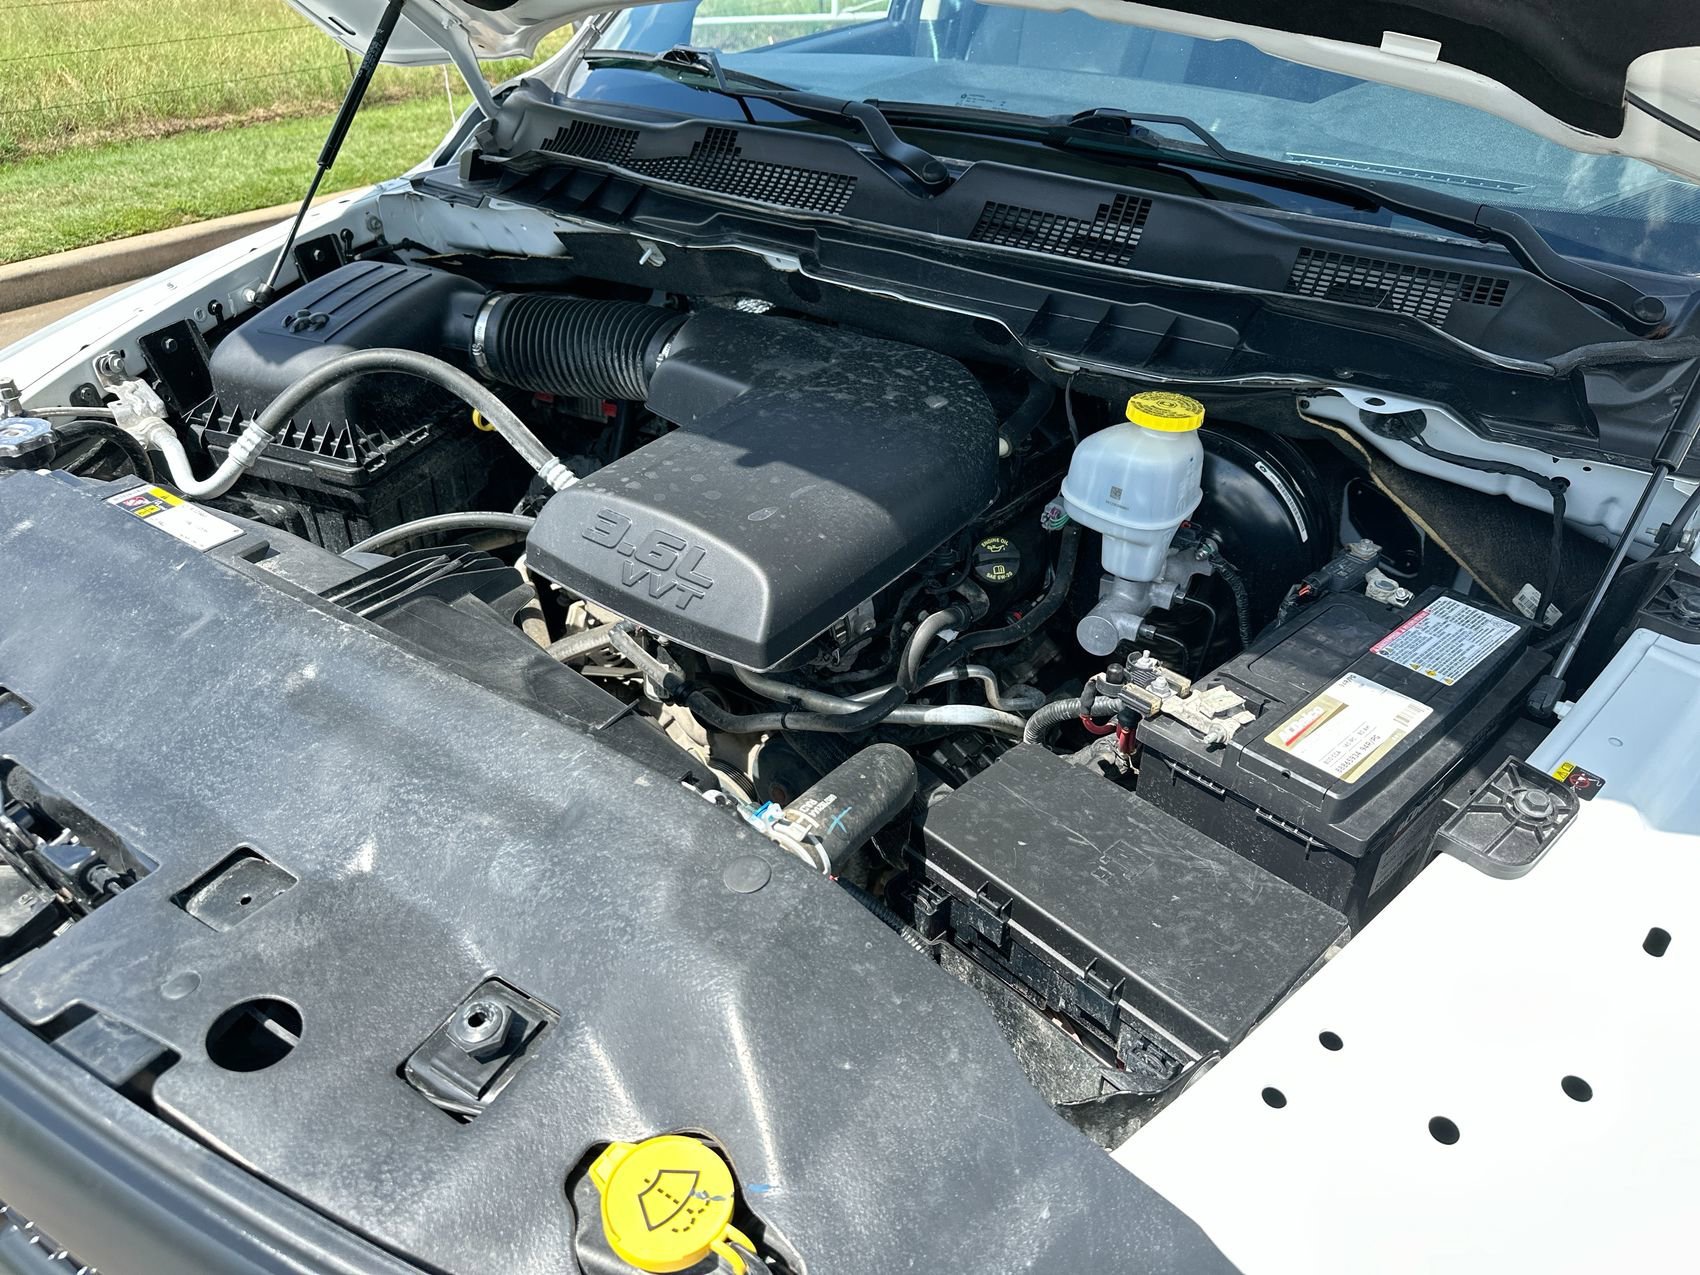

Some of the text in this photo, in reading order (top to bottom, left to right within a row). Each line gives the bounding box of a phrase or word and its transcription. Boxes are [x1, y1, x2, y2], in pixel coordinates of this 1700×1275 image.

[582, 507, 714, 588] 3.6L
[981, 538, 1009, 547] ENGINE OIL
[621, 559, 707, 611] VVT
